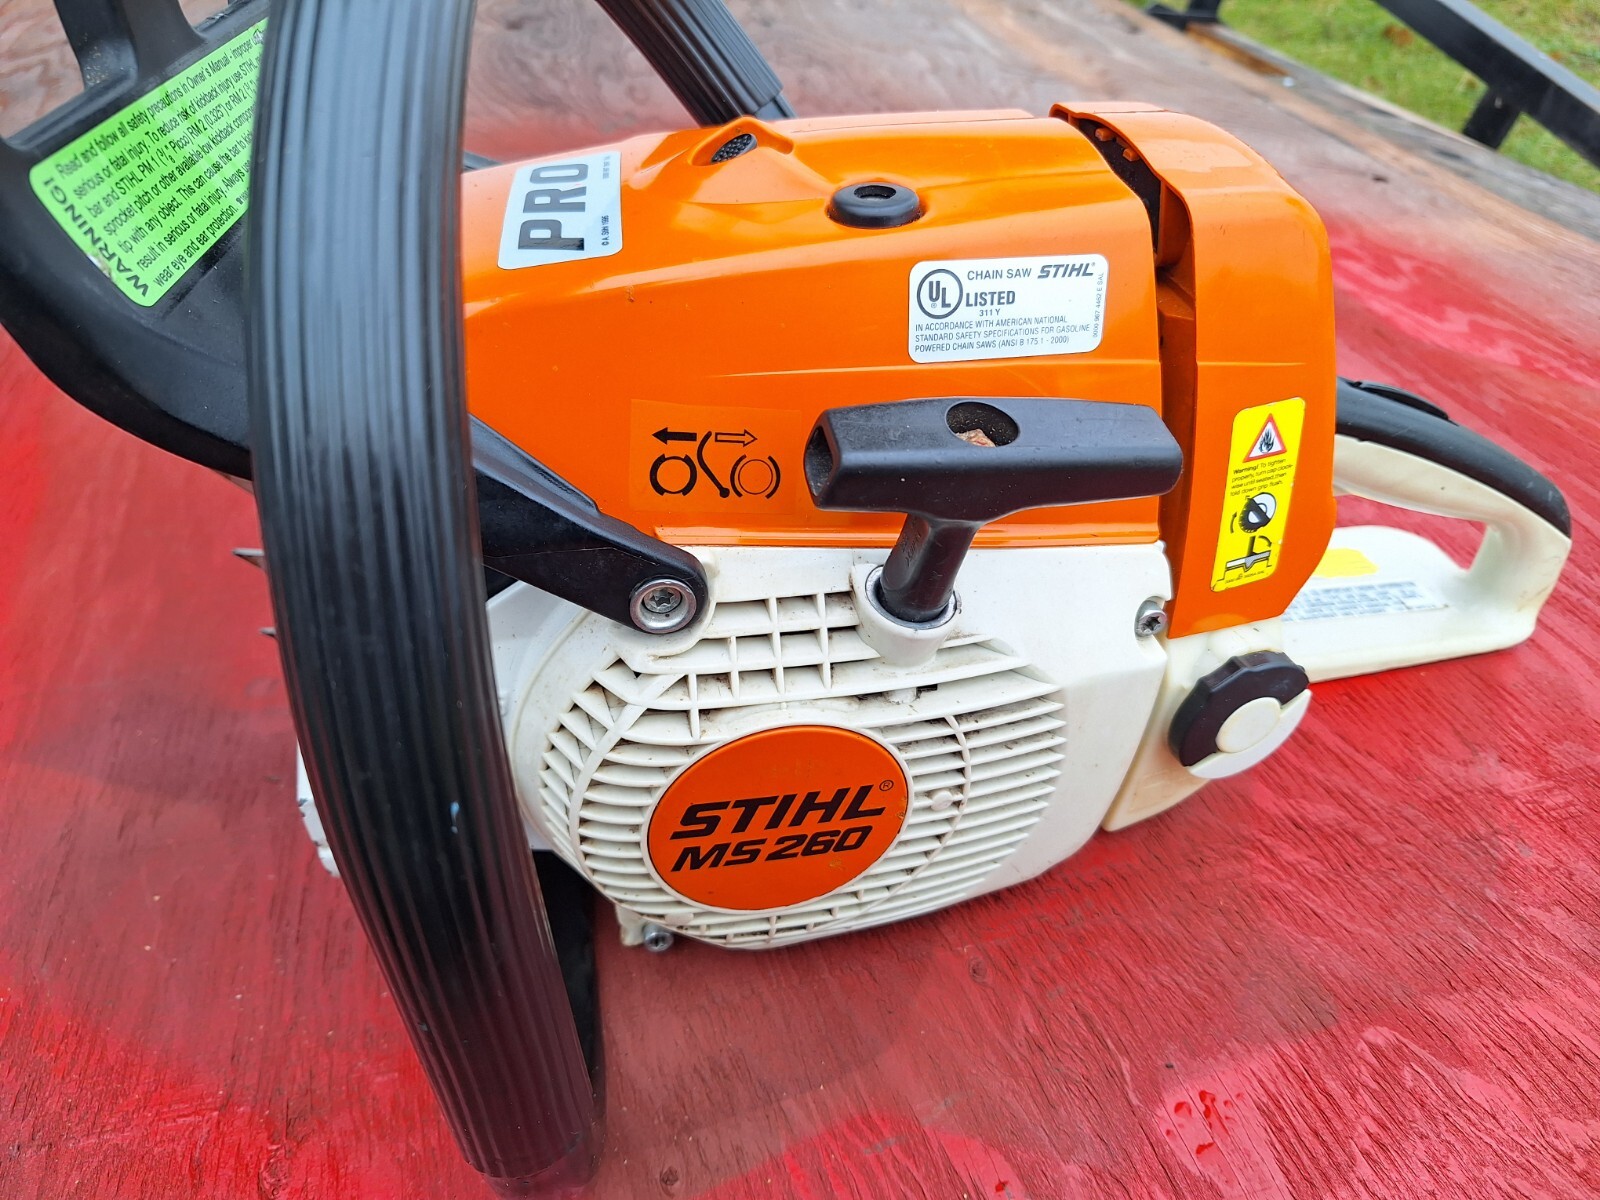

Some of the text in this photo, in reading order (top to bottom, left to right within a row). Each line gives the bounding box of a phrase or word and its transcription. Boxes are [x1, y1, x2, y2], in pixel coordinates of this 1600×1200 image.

[228, 91, 241, 104] RM
[239, 87, 247, 100] 2
[55, 153, 82, 179] Read
[81, 142, 98, 163] and
[94, 132, 119, 151] follow
[118, 121, 129, 138] all
[126, 110, 151, 131] safety
[147, 88, 183, 120] precautions
[179, 82, 190, 94] in
[207, 52, 231, 74] Manual
[230, 39, 253, 60] improper
[225, 101, 233, 111] or
[73, 172, 105, 199] serious
[102, 165, 113, 178] or
[109, 150, 130, 171] fatal
[124, 140, 150, 160] injury.
[145, 131, 160, 144] To
[157, 117, 179, 138] reduce
[177, 107, 191, 123] risk
[188, 97, 198, 114] of
[193, 86, 220, 111] kickback
[215, 77, 235, 94] injury
[231, 70, 243, 83] use
[239, 58, 258, 76] STIHL
[186, 122, 203, 140] RM
[198, 119, 207, 131] 2
[169, 131, 194, 154] Picco)
[137, 159, 156, 178] PM
[150, 155, 160, 167] 1
[103, 202, 138, 236] sprocket
[133, 190, 155, 213] pitch
[151, 184, 162, 196] or
[159, 170, 178, 190] other
[176, 149, 204, 176] available
[198, 142, 213, 155] low
[208, 121, 236, 147] kickback
[115, 171, 143, 195] STIHL
[222, 169, 246, 191] Always
[102, 187, 120, 207] and
[118, 240, 134, 254] tip
[129, 226, 149, 244] with
[145, 215, 163, 232] any
[158, 196, 183, 220] object.
[176, 185, 196, 200] This
[192, 175, 207, 190] can
[204, 160, 223, 179] cause
[218, 153, 232, 165] the
[227, 145, 241, 157] bar
[236, 140, 247, 150] to
[204, 187, 228, 205] injury.
[87, 201, 103, 218] bar
[191, 198, 211, 218] fatal
[518, 163, 588, 251] PRO
[186, 213, 197, 224] or
[43, 177, 149, 297] WARNING!
[163, 220, 190, 246] serious
[153, 205, 238, 287] wear eye and ear protection.
[153, 241, 167, 252] in
[137, 246, 160, 271] result
[967, 262, 1094, 280] CHAIN SAW STIHL
[928, 280, 952, 308] UL
[965, 290, 1016, 307] LISTED
[979, 308, 1001, 317] 311 Y
[915, 323, 1090, 342] STANDARD SAFETY SPECIFICATIONS FOR GASOLINE
[925, 321, 973, 331] ACCORDANCE
[975, 320, 994, 328] WITH
[995, 317, 1033, 327] AMERICAN
[1034, 315, 1067, 325] NATIONAL
[915, 343, 951, 352] POWERED
[952, 341, 974, 351] CHAIN
[976, 340, 997, 349] SAWS
[998, 338, 1018, 348] (ANSI
[1019, 338, 1025, 346] B
[1050, 335, 1069, 344] 2000)
[1233, 464, 1259, 475] Warning!
[1267, 459, 1286, 467] tighten
[1257, 483, 1268, 491] grip
[669, 784, 886, 840] STIHL
[670, 825, 873, 872] MS 260
